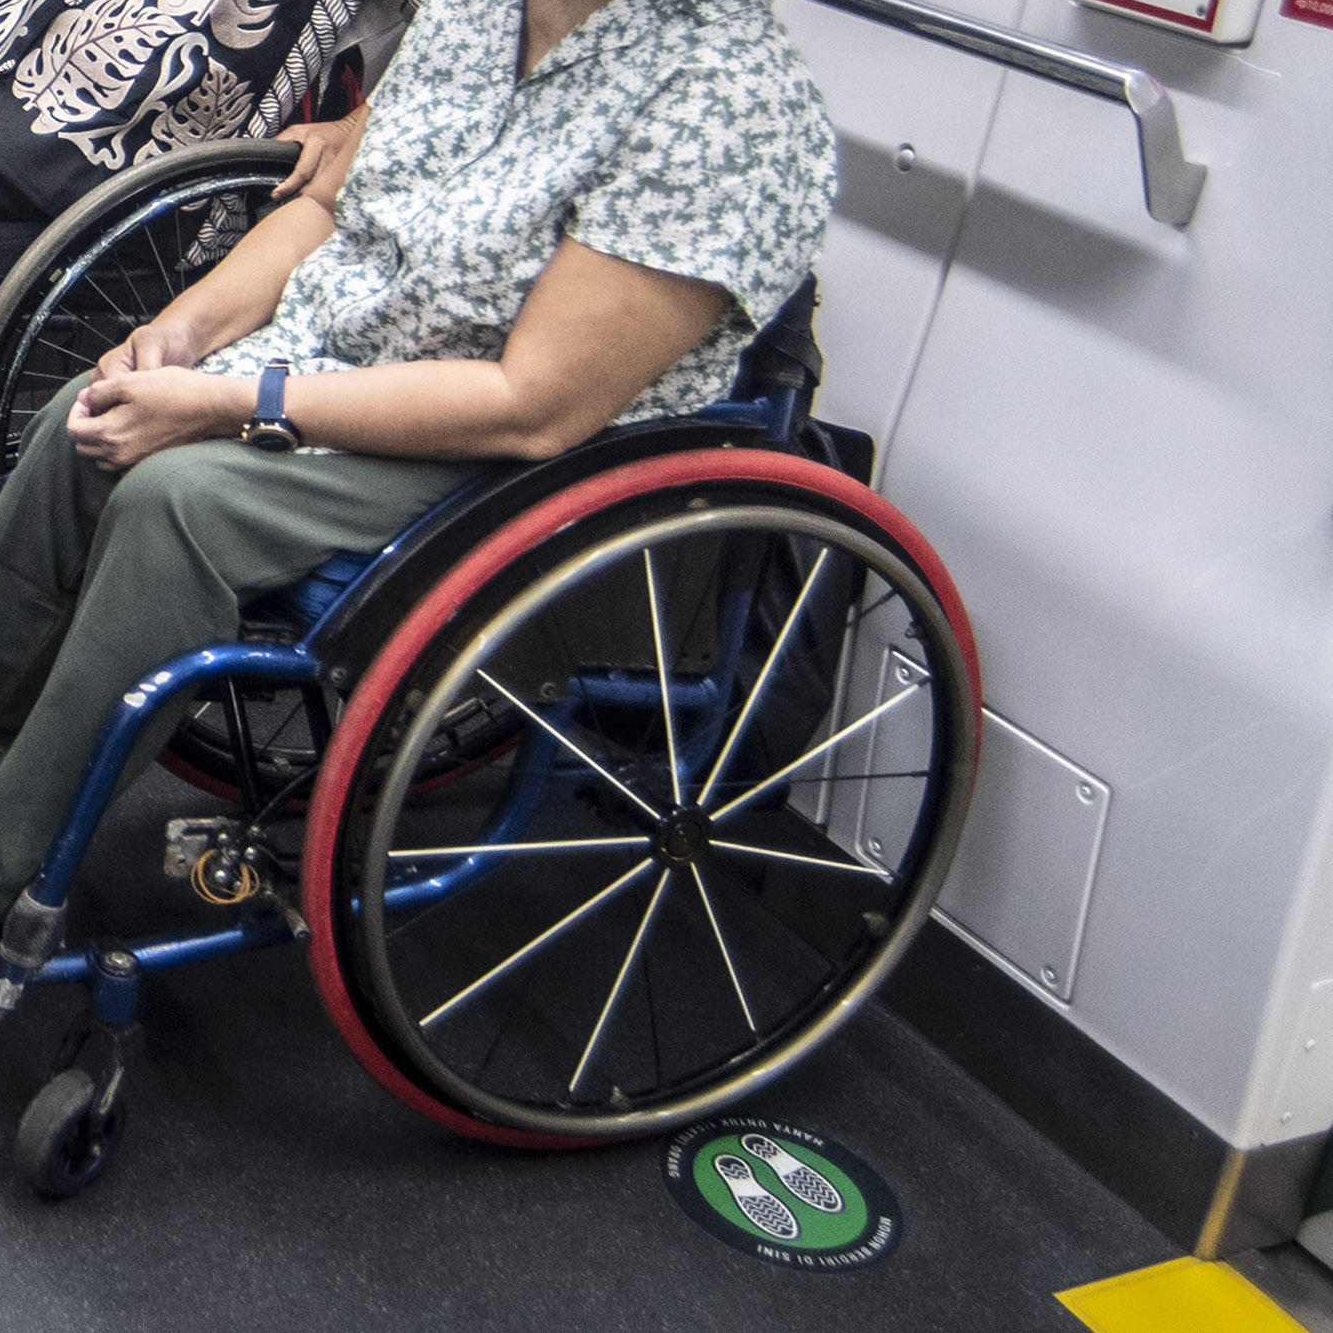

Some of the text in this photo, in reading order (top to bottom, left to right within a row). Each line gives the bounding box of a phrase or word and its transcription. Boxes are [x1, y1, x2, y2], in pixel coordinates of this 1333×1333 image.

[773, 1122, 824, 1147] HANYA
[667, 1143, 683, 1179] ORANG
[757, 1216, 893, 1267] MOHON BERDIRI DI SINI
